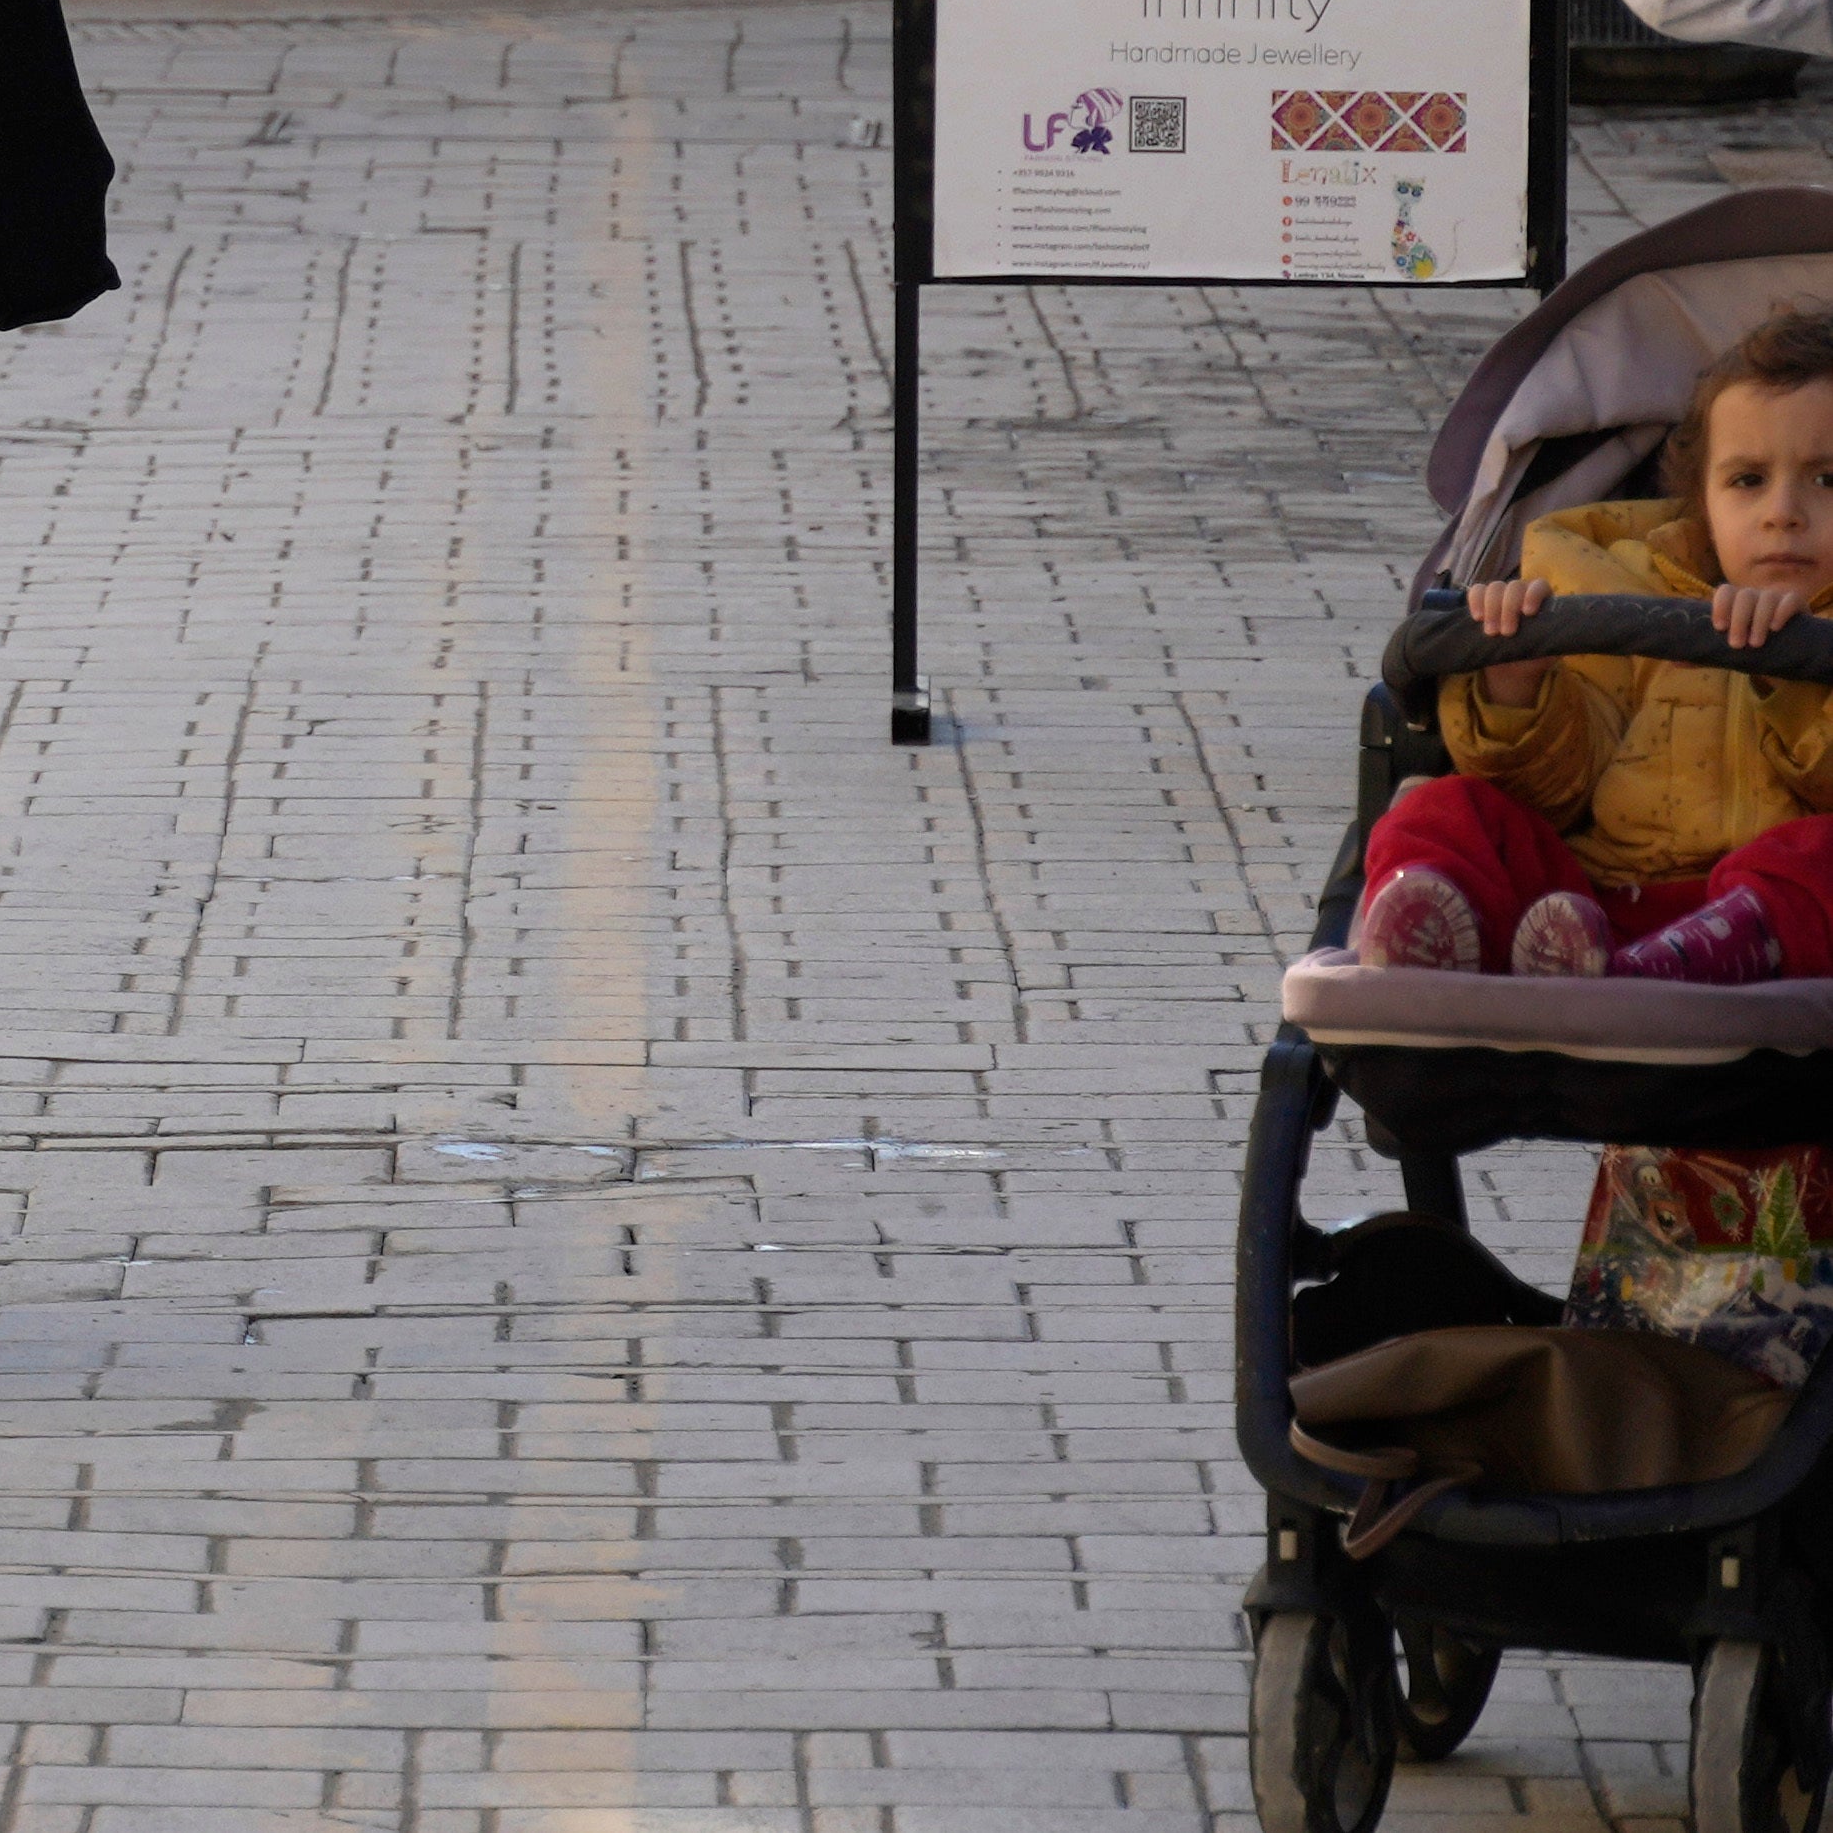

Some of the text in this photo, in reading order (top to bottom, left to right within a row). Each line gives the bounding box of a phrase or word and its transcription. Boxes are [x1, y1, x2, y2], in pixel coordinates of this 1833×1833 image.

[1110, 41, 1362, 71] Handmade Jewellery
[1023, 112, 1070, 153] LF
